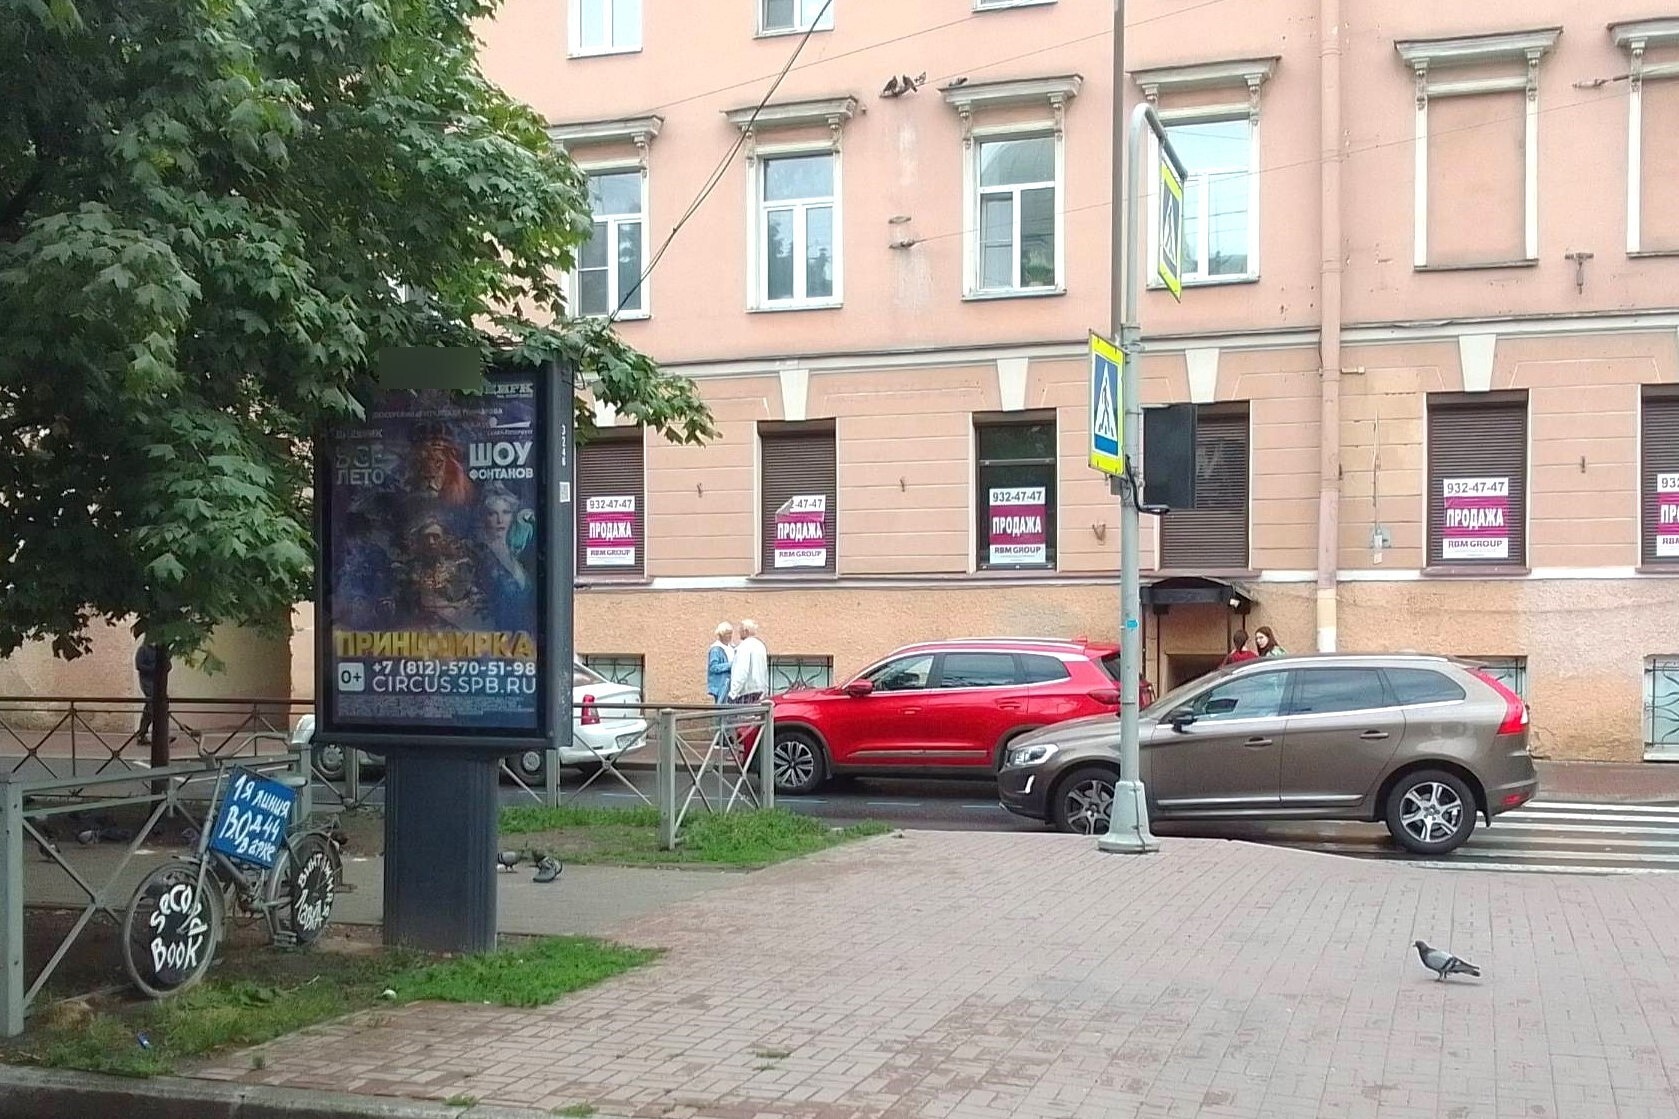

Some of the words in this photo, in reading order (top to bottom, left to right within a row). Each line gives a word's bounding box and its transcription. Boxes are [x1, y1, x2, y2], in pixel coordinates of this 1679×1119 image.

[470, 441, 533, 467] ШОУ
[336, 468, 385, 485] ЛЕТО
[469, 467, 534, 481] ФОНТАНОВ
[992, 491, 1042, 502] 932-47-47
[1446, 482, 1505, 494] 932-47-47
[589, 499, 633, 509] 932-47-47
[1446, 508, 1504, 530] ПРОДАЖА
[1660, 504, 1679, 523] ПР
[589, 521, 632, 541] ПРОДАЖА
[777, 522, 823, 542] ПРОДАЖА
[992, 516, 1042, 537] ПРОДАЖА
[372, 661, 393, 674] +7
[401, 660, 536, 676] (812)-570-51-98
[341, 670, 362, 684] 0+
[373, 676, 536, 693] CIRCUS.SPB.RU
